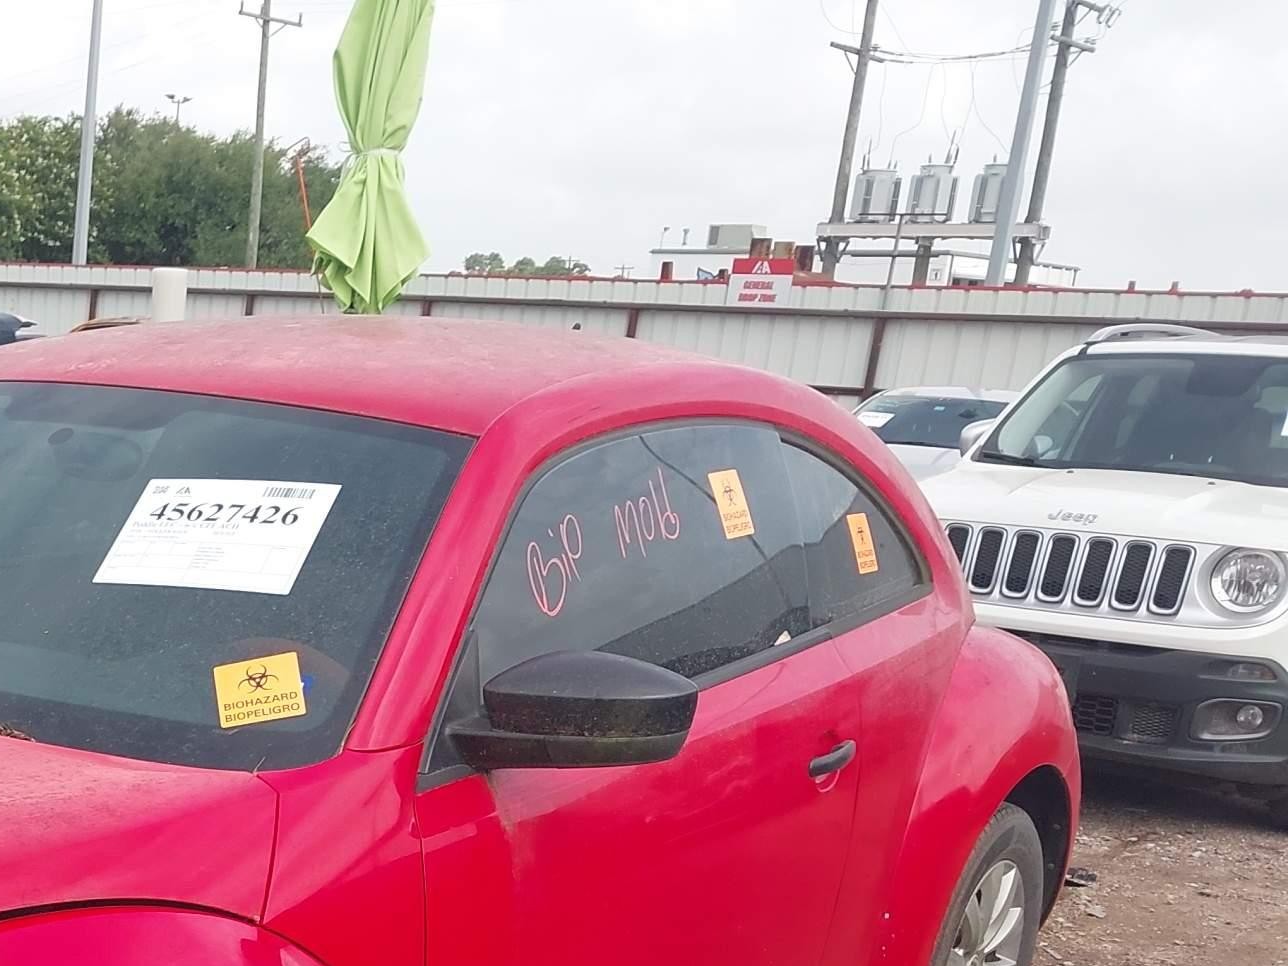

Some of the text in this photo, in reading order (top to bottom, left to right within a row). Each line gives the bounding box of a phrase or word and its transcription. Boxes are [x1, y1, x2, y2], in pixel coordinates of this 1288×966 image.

[149, 502, 305, 526] 45627426
[1047, 508, 1099, 526] Jeep
[224, 691, 298, 712] BIOHAZARD
[225, 702, 300, 723] BIOPELIGRO
